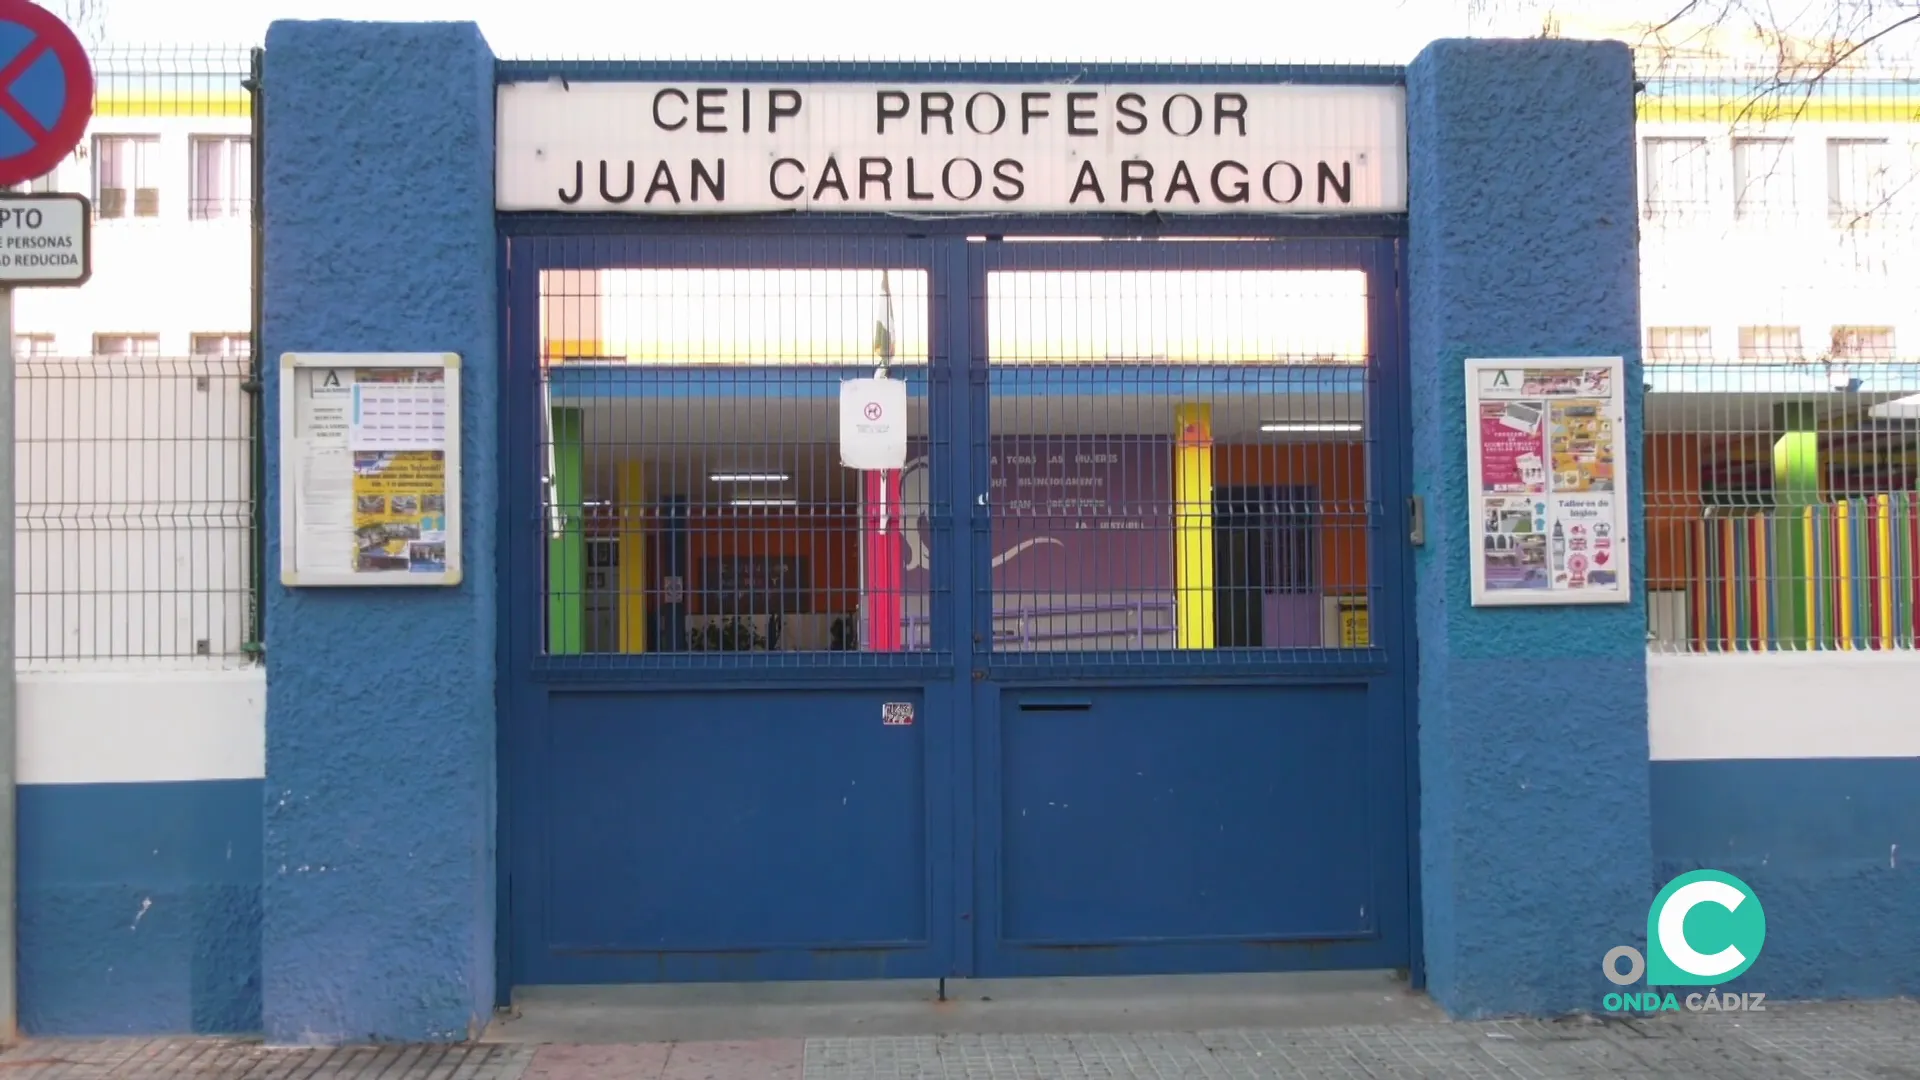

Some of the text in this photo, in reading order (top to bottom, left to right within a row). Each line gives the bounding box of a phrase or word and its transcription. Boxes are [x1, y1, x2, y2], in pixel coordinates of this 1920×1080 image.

[652, 87, 1248, 136] CEIP PROFESOR
[558, 156, 1351, 205] JUAN CARLOS ARAGON
[7, 236, 73, 249] PERSONAS
[15, 253, 79, 267] REDUCIDA
